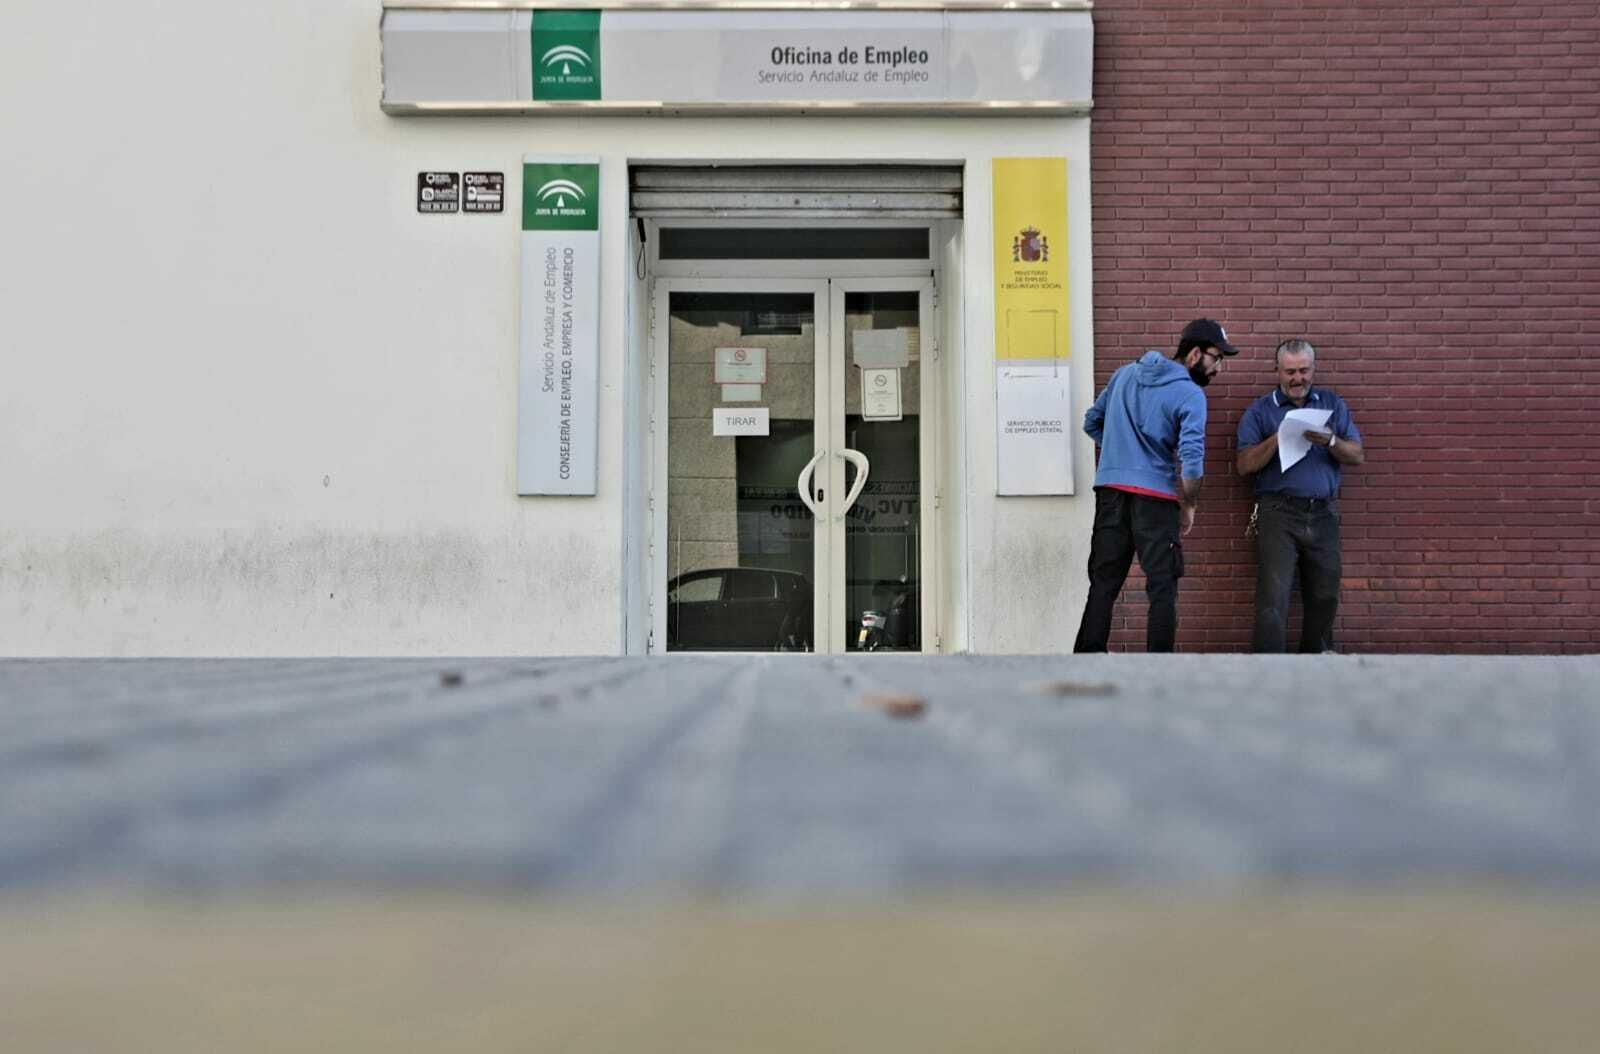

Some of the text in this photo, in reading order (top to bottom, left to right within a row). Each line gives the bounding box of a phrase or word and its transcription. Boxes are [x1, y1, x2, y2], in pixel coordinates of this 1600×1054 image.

[771, 46, 929, 68] Oficina de Empleo
[758, 70, 929, 84] Servicio Andaluz de Empleo
[542, 247, 559, 393] Servicio Andaluz de Empleo
[558, 247, 575, 480] CONSEJERÍA DE EMPLEO, EMPRESA Y COMERCIO
[725, 416, 757, 426] TIRAR
